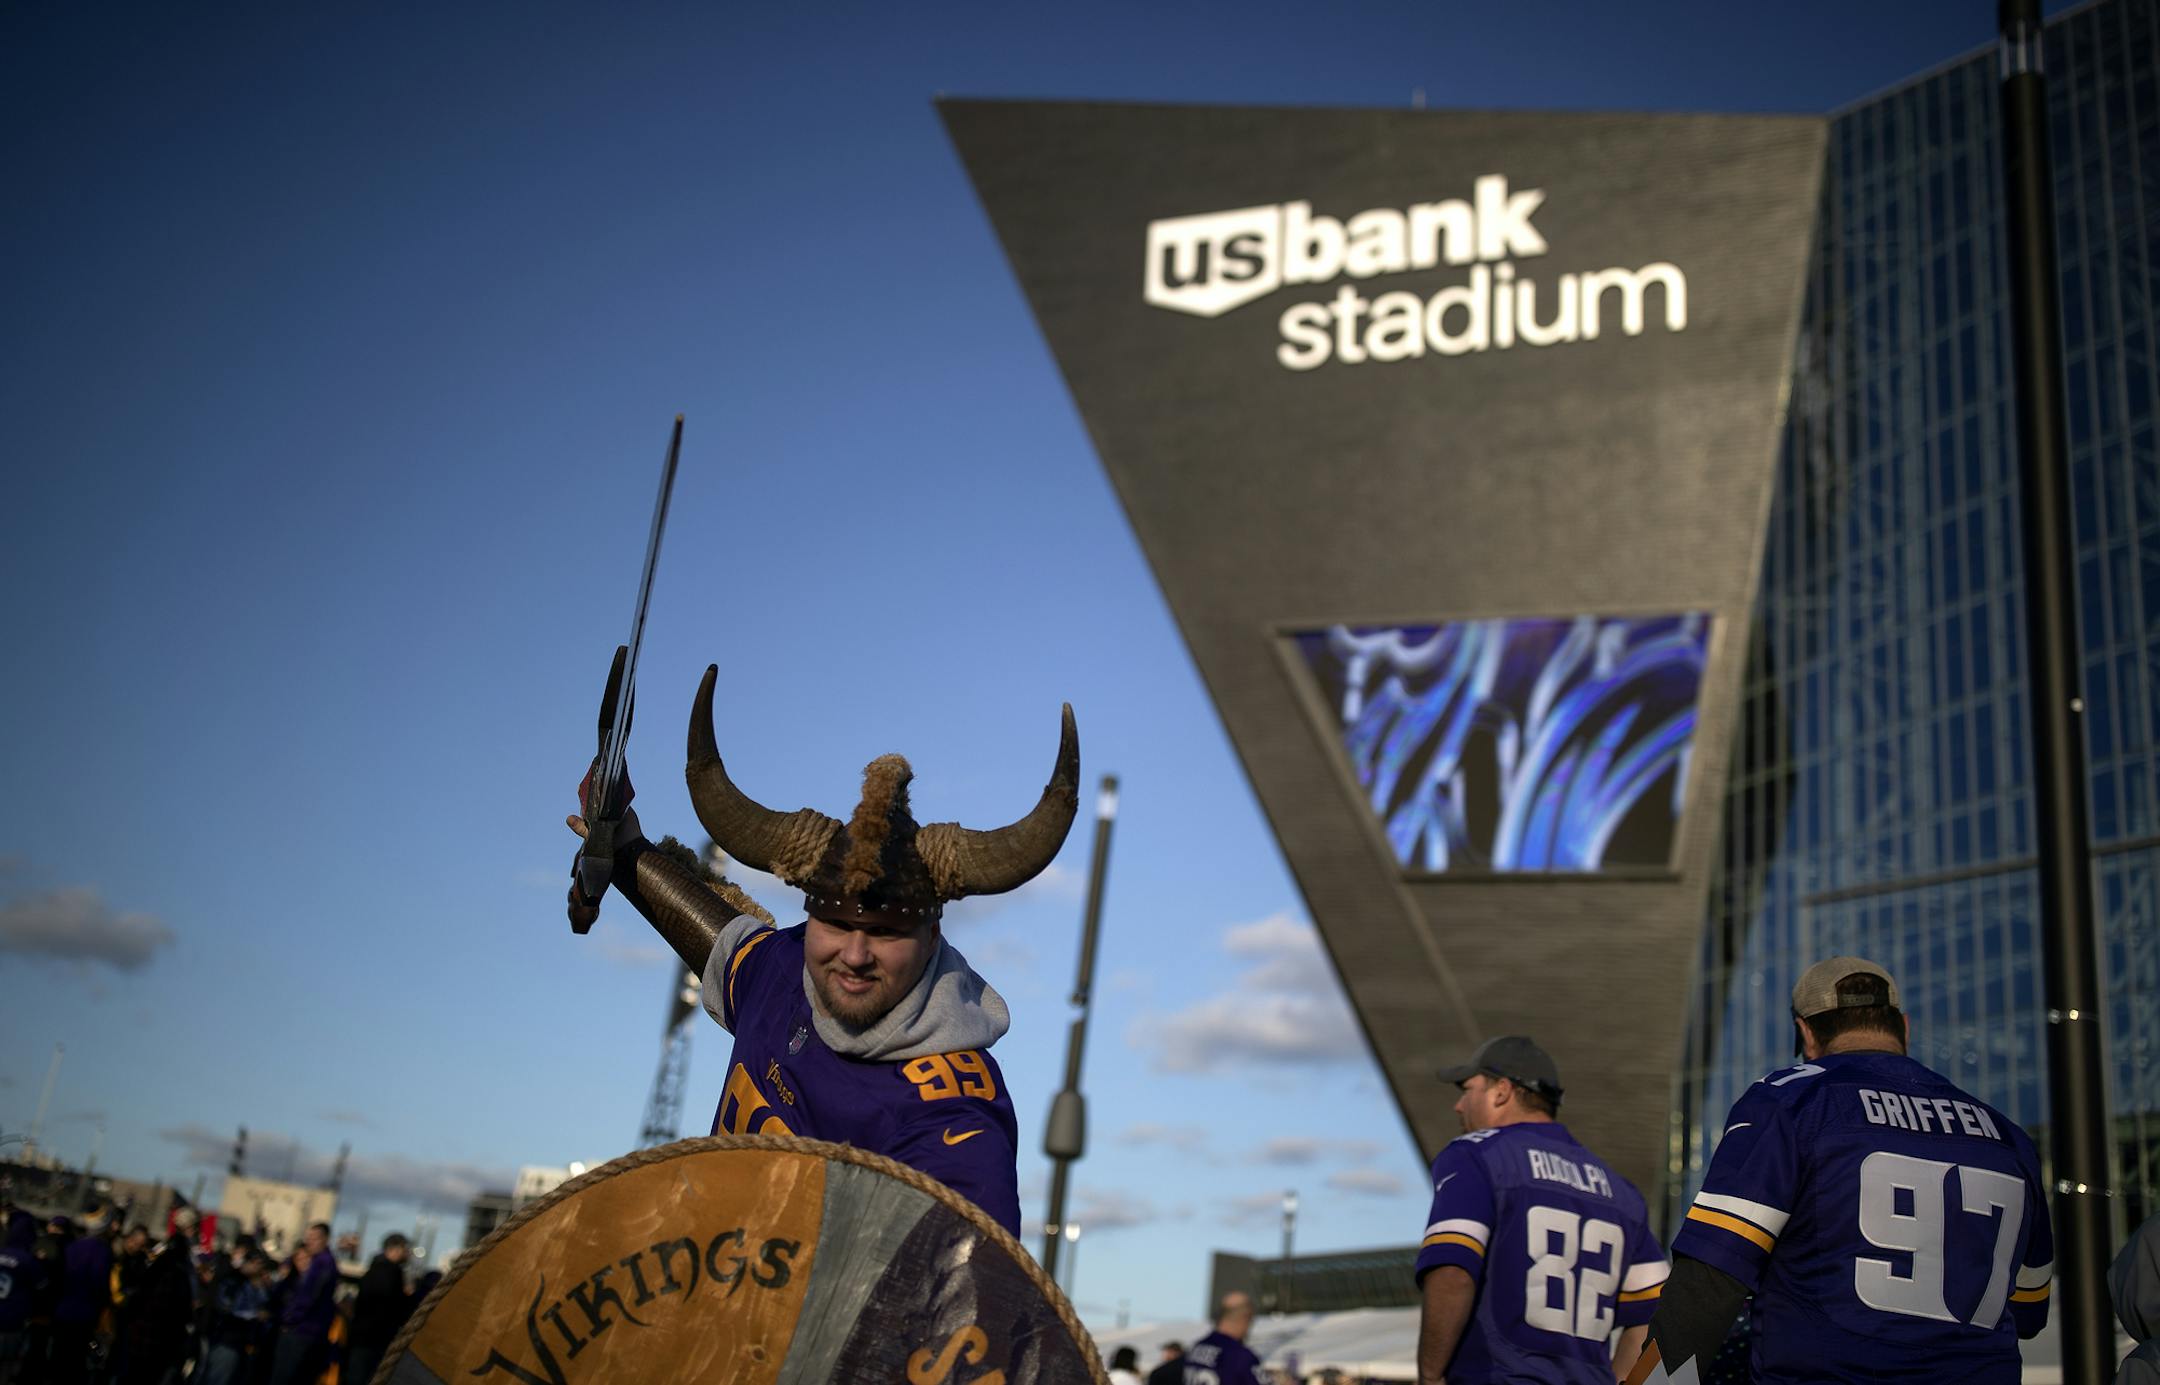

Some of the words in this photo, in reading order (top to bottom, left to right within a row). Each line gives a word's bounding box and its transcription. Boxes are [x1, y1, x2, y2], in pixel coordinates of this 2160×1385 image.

[1282, 173, 1548, 285] bank
[1277, 262, 1687, 371] stadium
[902, 1050, 997, 1102] 99
[1858, 1088, 2001, 1140] GRIFFEN
[1527, 1148, 1614, 1199] RUDOLPH
[1524, 1205, 1625, 1342] 82
[1854, 1151, 2026, 1331] 97
